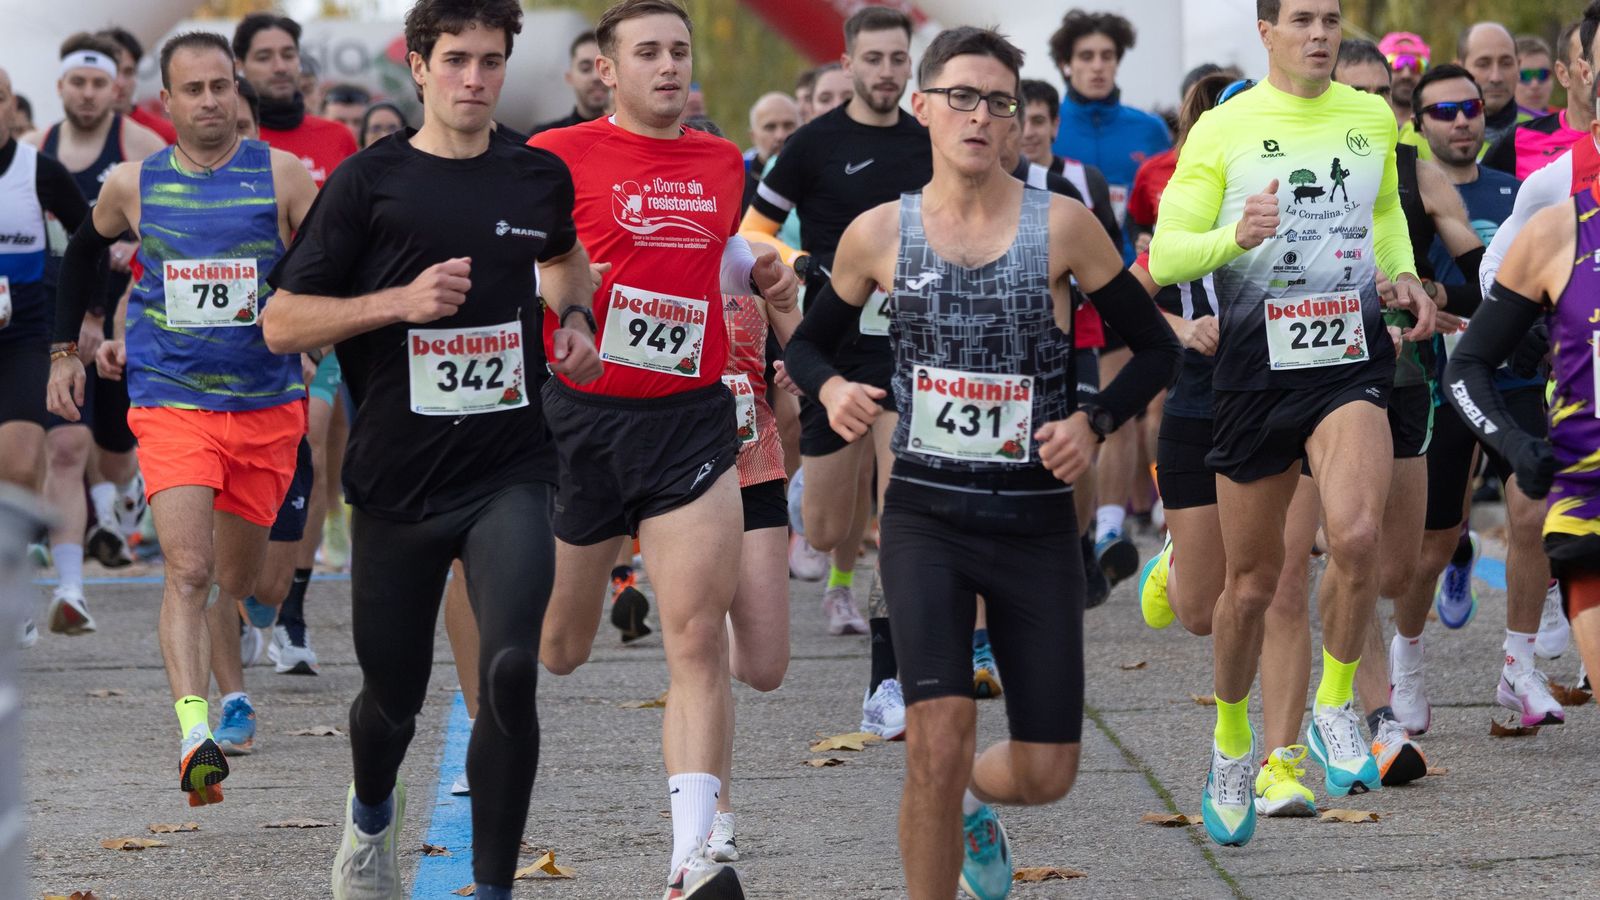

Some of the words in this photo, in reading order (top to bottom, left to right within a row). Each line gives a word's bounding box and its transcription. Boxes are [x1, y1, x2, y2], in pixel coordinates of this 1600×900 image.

[687, 179, 704, 195] sin
[647, 194, 718, 213] resistencias!
[1285, 204, 1297, 215] La
[1298, 209, 1344, 221] Corralina,
[166, 263, 256, 281] bedunia
[192, 283, 229, 310] 78
[612, 289, 706, 326] bedunia
[1267, 295, 1360, 321] bedunia
[412, 329, 520, 356] bedunia
[628, 318, 688, 355] 949
[1289, 318, 1347, 350] 222
[437, 357, 505, 392] 342
[917, 377, 1030, 402] bedunia
[1449, 379, 1487, 428] TERREX
[935, 401, 1003, 439] 431
